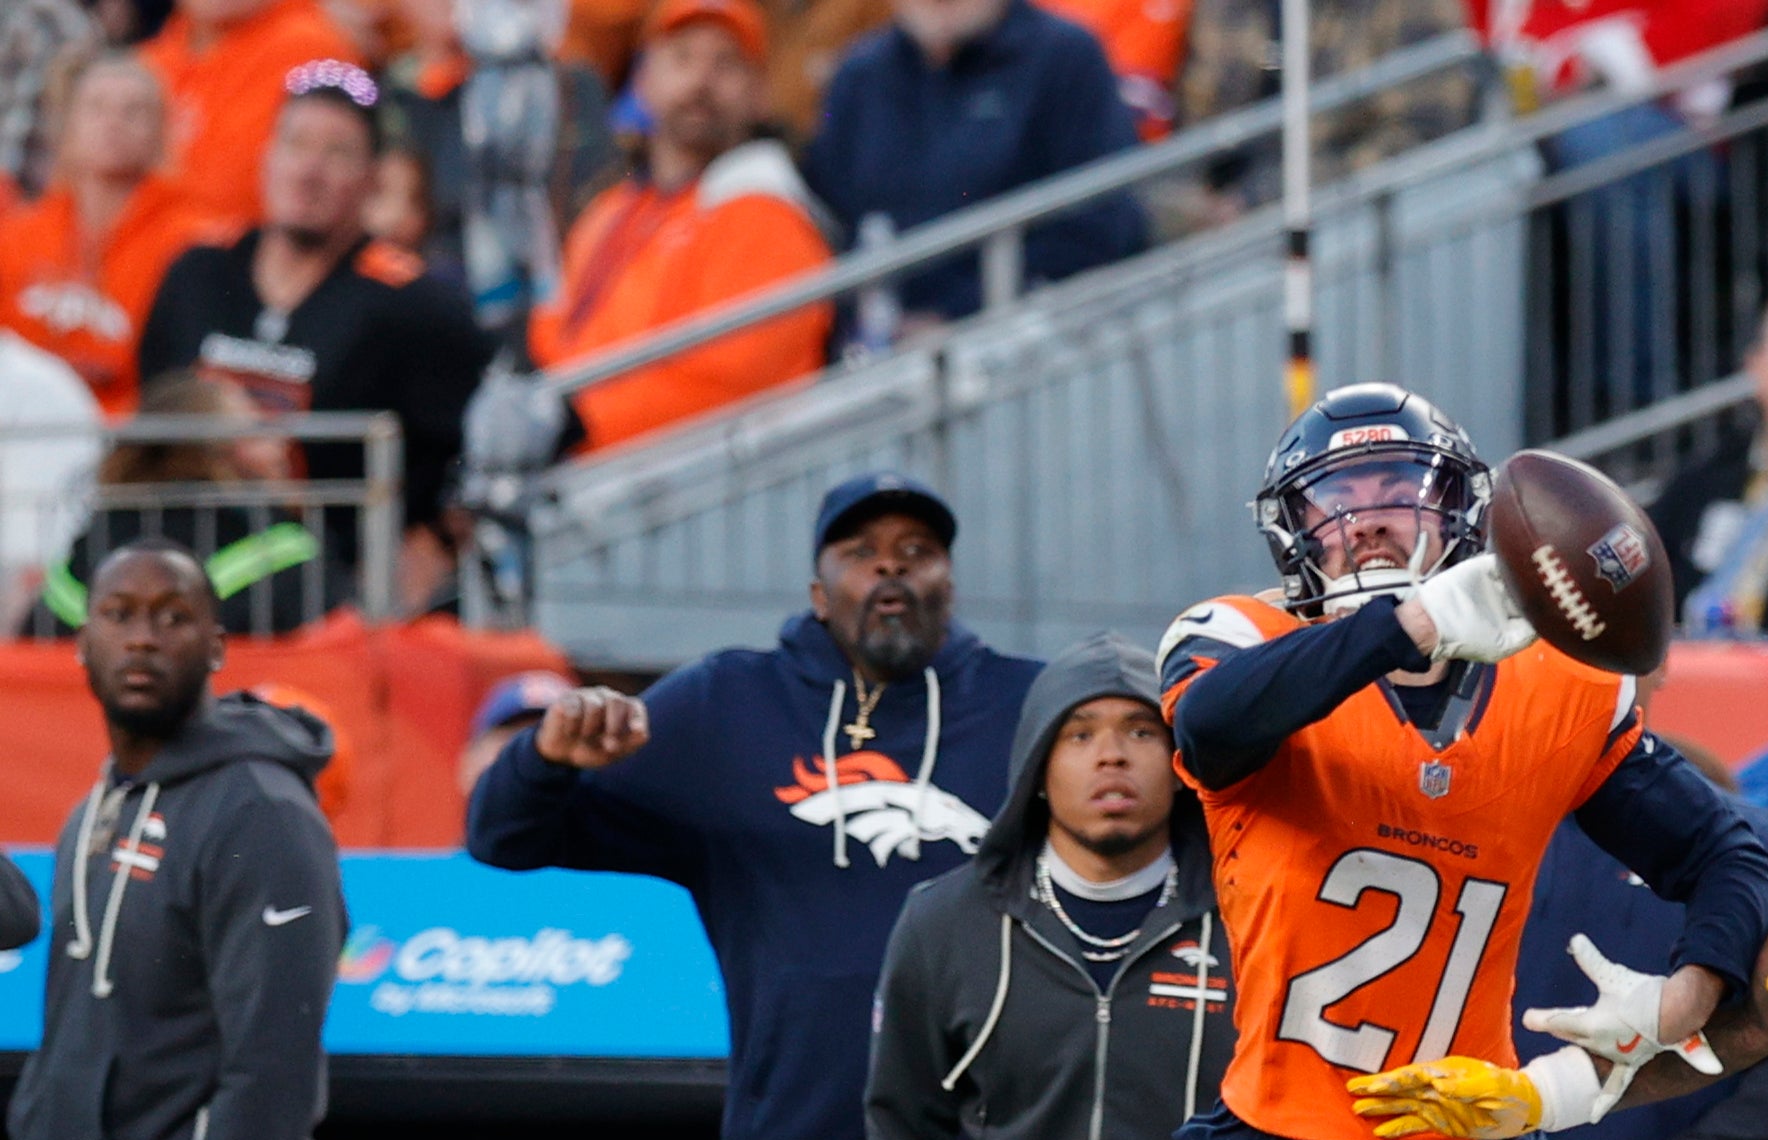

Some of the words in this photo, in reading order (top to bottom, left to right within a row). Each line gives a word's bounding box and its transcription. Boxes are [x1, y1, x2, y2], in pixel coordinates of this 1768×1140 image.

[1376, 823, 1479, 860] BRONCOS
[396, 927, 632, 985] Copilot
[1275, 846, 1510, 1076] 21
[1146, 996, 1226, 1014] AFC-WST
